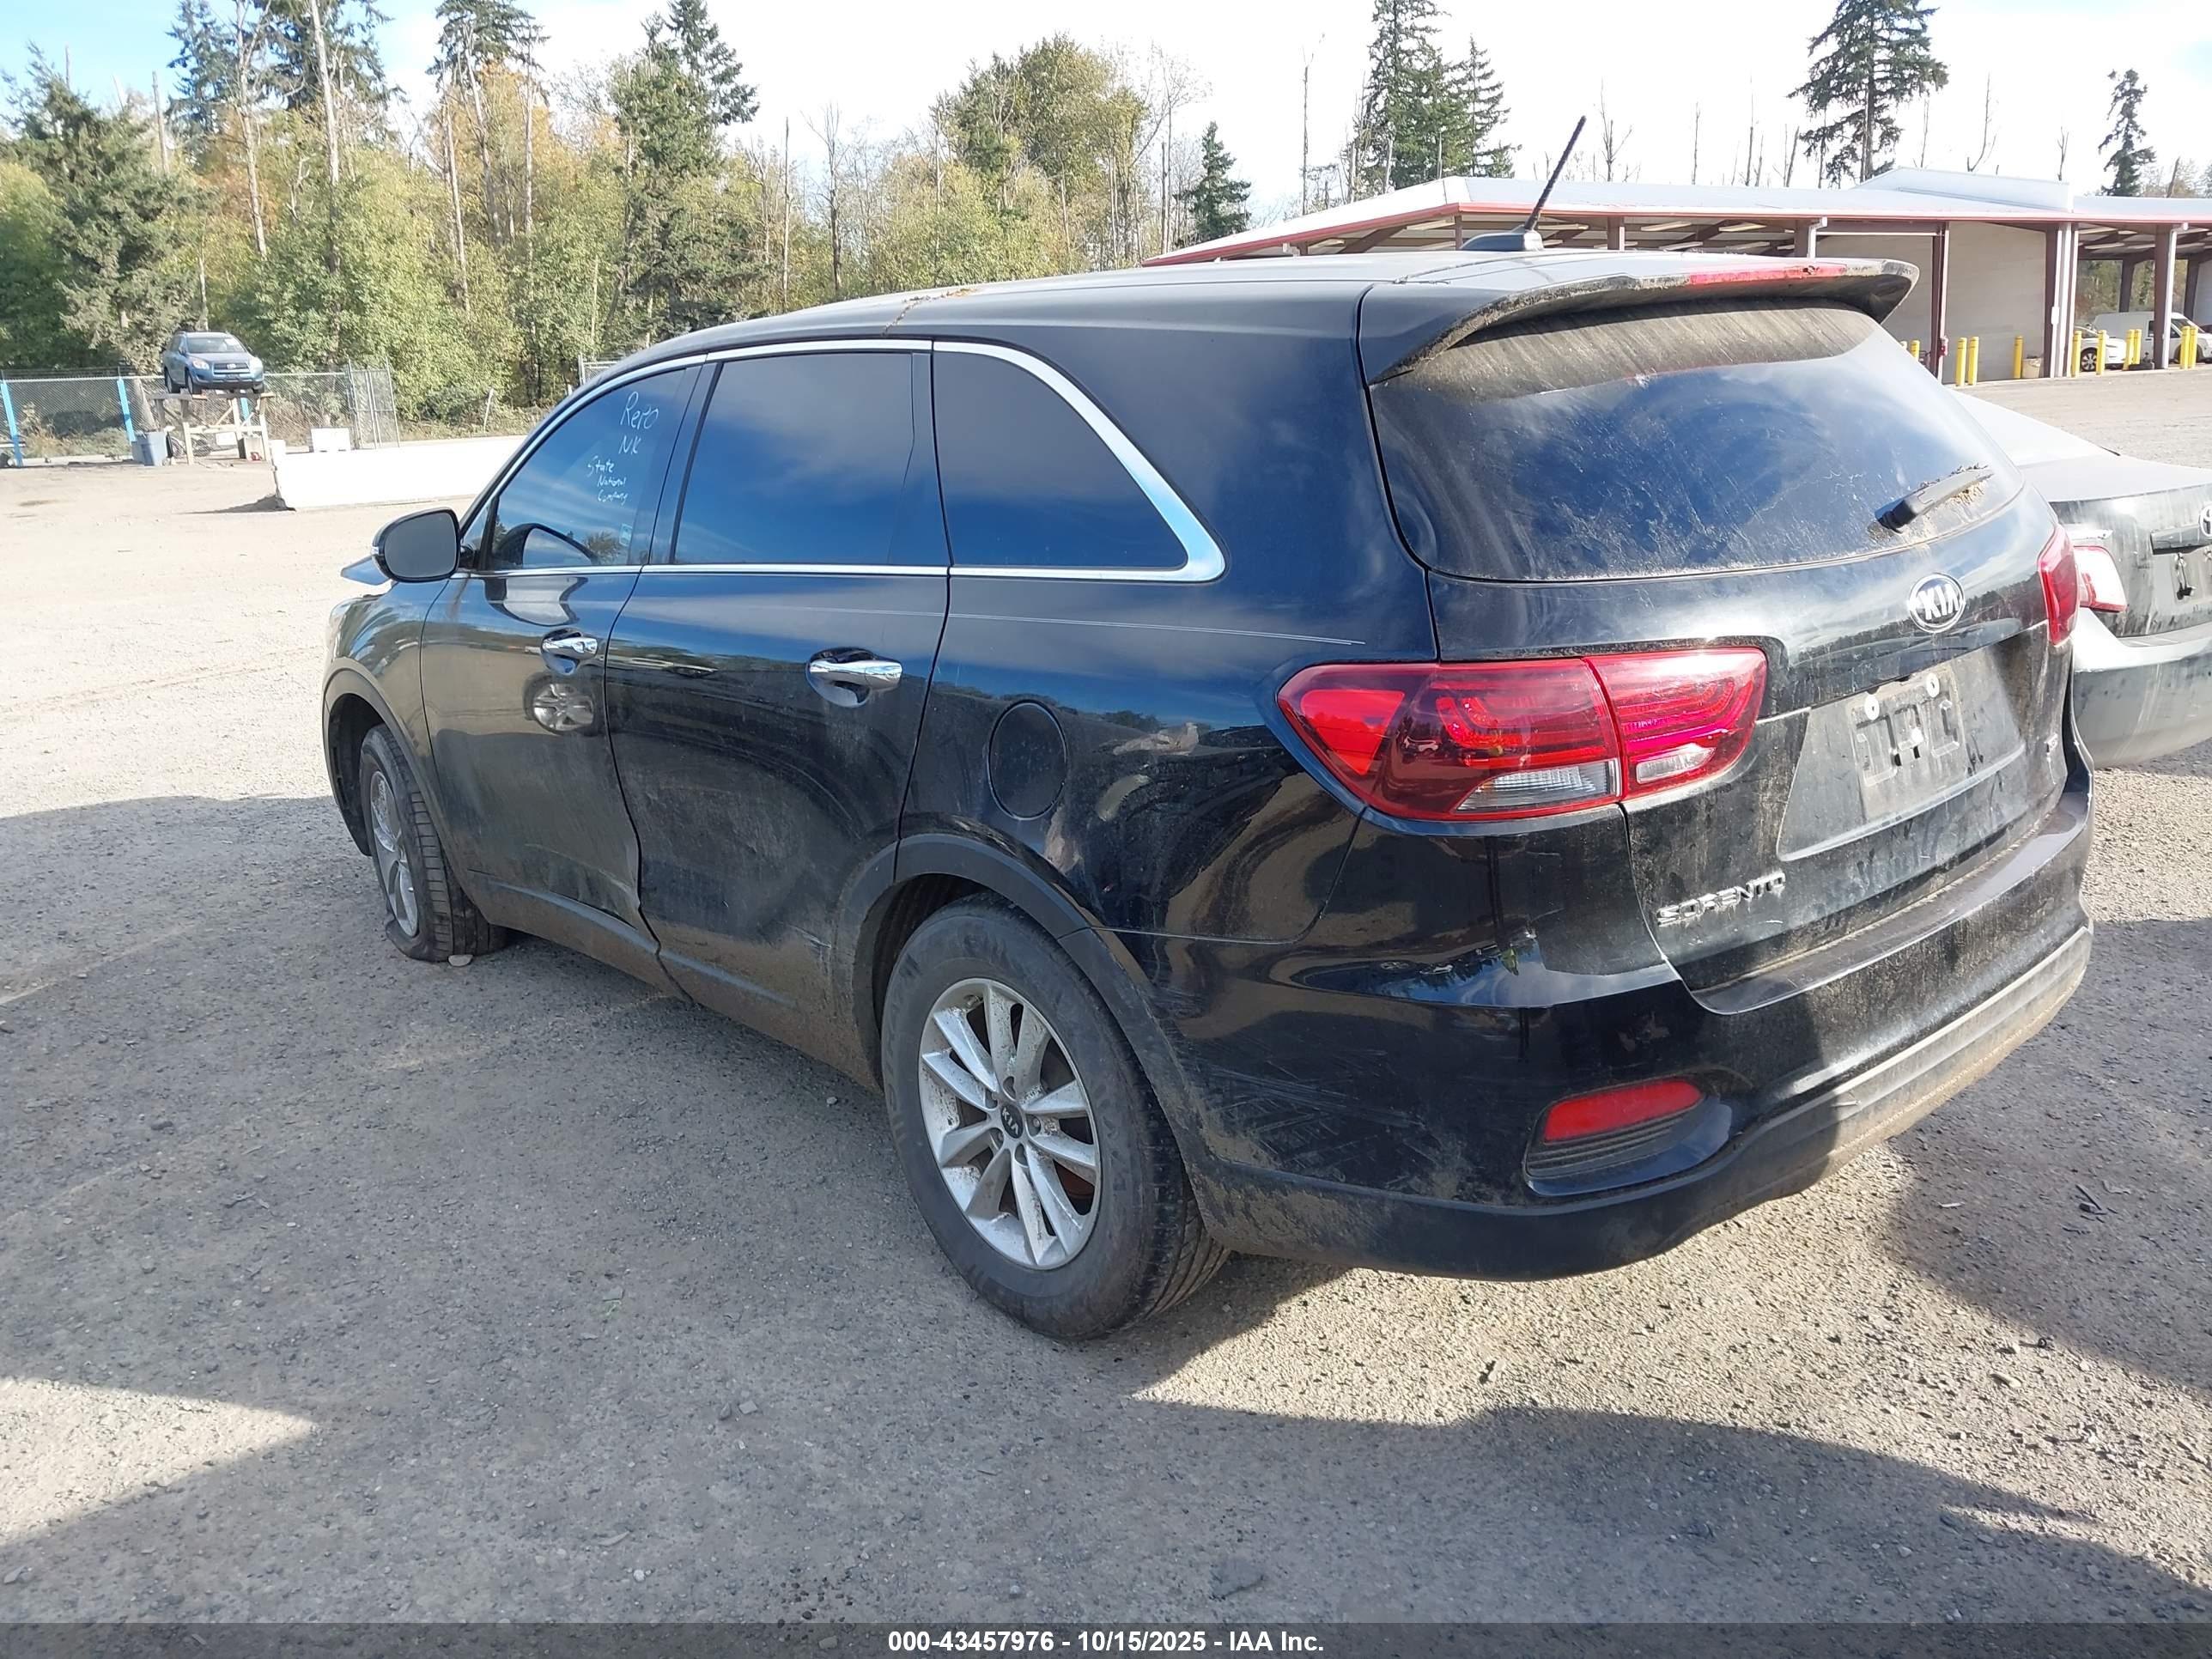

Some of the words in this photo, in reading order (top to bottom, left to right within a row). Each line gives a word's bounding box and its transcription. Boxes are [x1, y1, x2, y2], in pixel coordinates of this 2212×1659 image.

[586, 455, 615, 477] State
[1917, 583, 1960, 620] KIA
[1656, 871, 1786, 927] SORENTO
[1001, 1106, 1019, 1135] KIA
